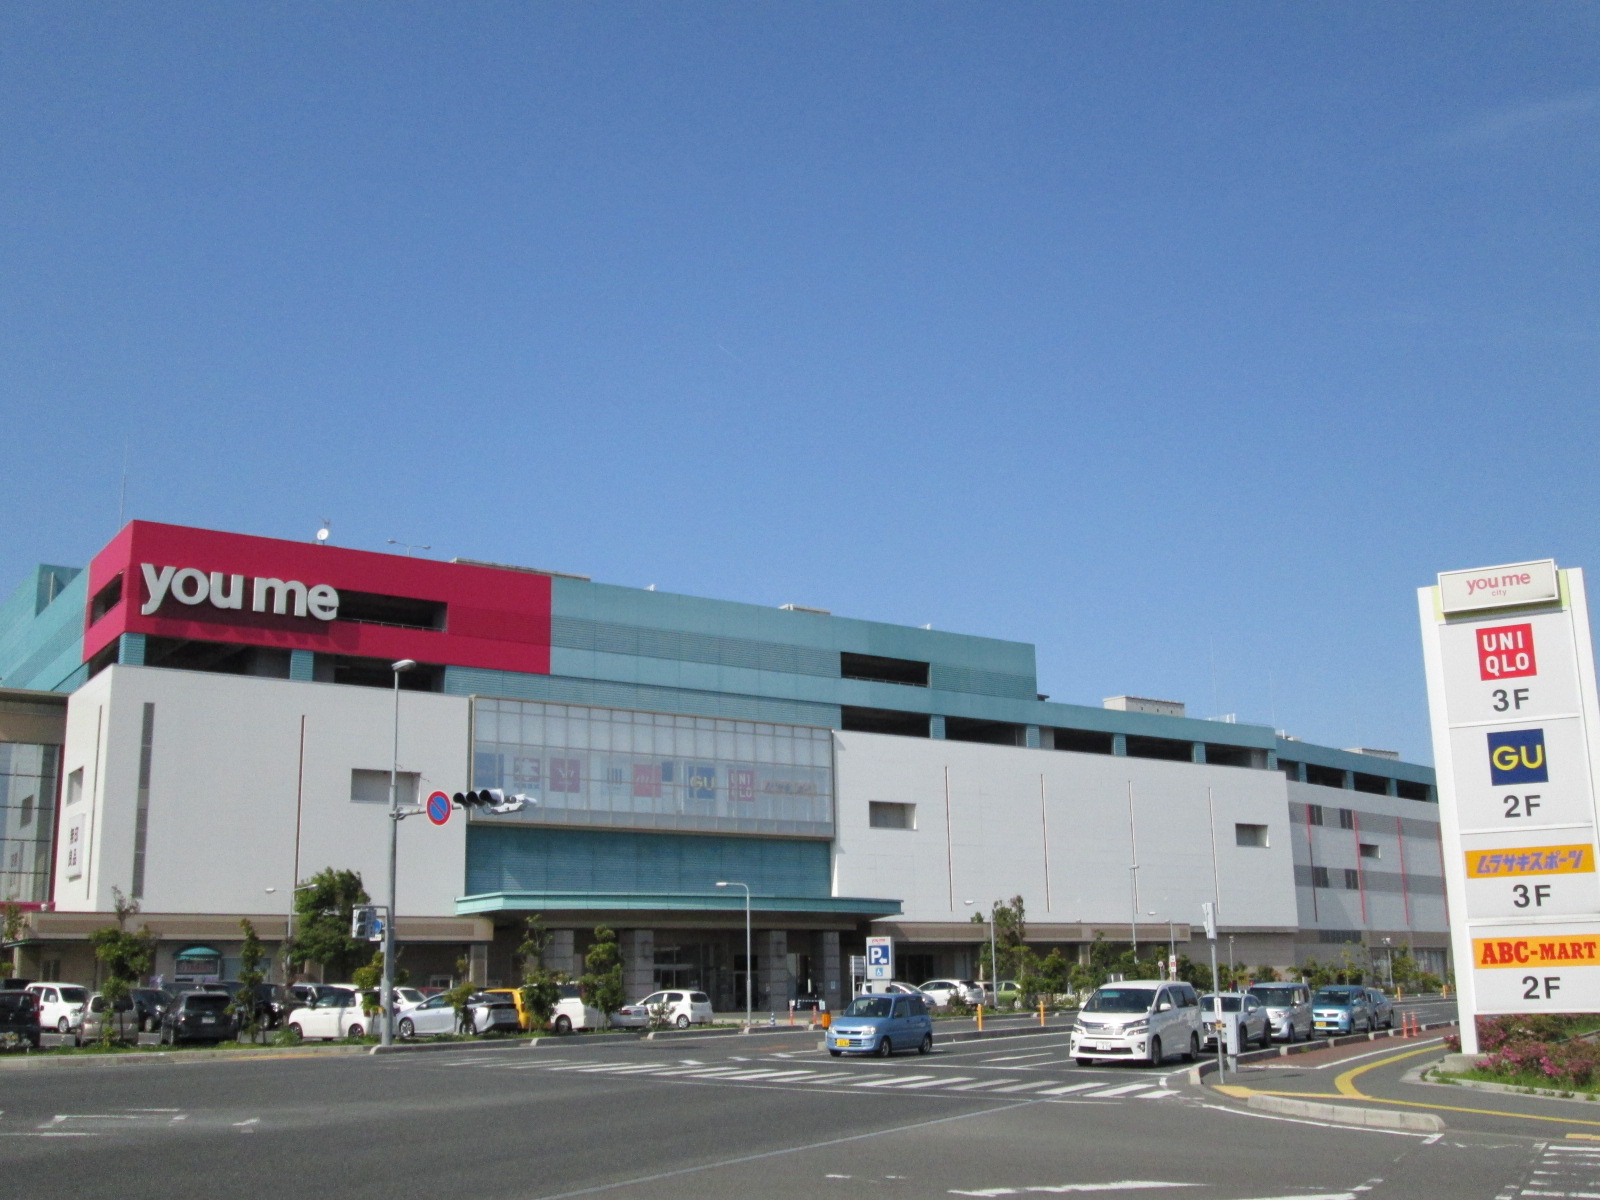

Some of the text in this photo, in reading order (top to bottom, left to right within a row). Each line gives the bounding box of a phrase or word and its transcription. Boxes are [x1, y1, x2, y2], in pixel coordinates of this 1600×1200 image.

[141, 562, 340, 621] you me
[1465, 572, 1531, 596] you me
[1491, 589, 1507, 597] city
[1483, 630, 1524, 652] UNI
[1485, 652, 1530, 677] QLO
[1492, 688, 1530, 712] 3F
[1492, 744, 1544, 771] GU
[690, 775, 717, 791] GU
[1503, 794, 1541, 818] 2F
[1476, 850, 1584, 874] ムラサキスポーツ
[1512, 884, 1551, 908] 3F
[870, 947, 882, 964] P
[1481, 941, 1596, 965] ABC-MART
[1521, 976, 1561, 1000] 2F
